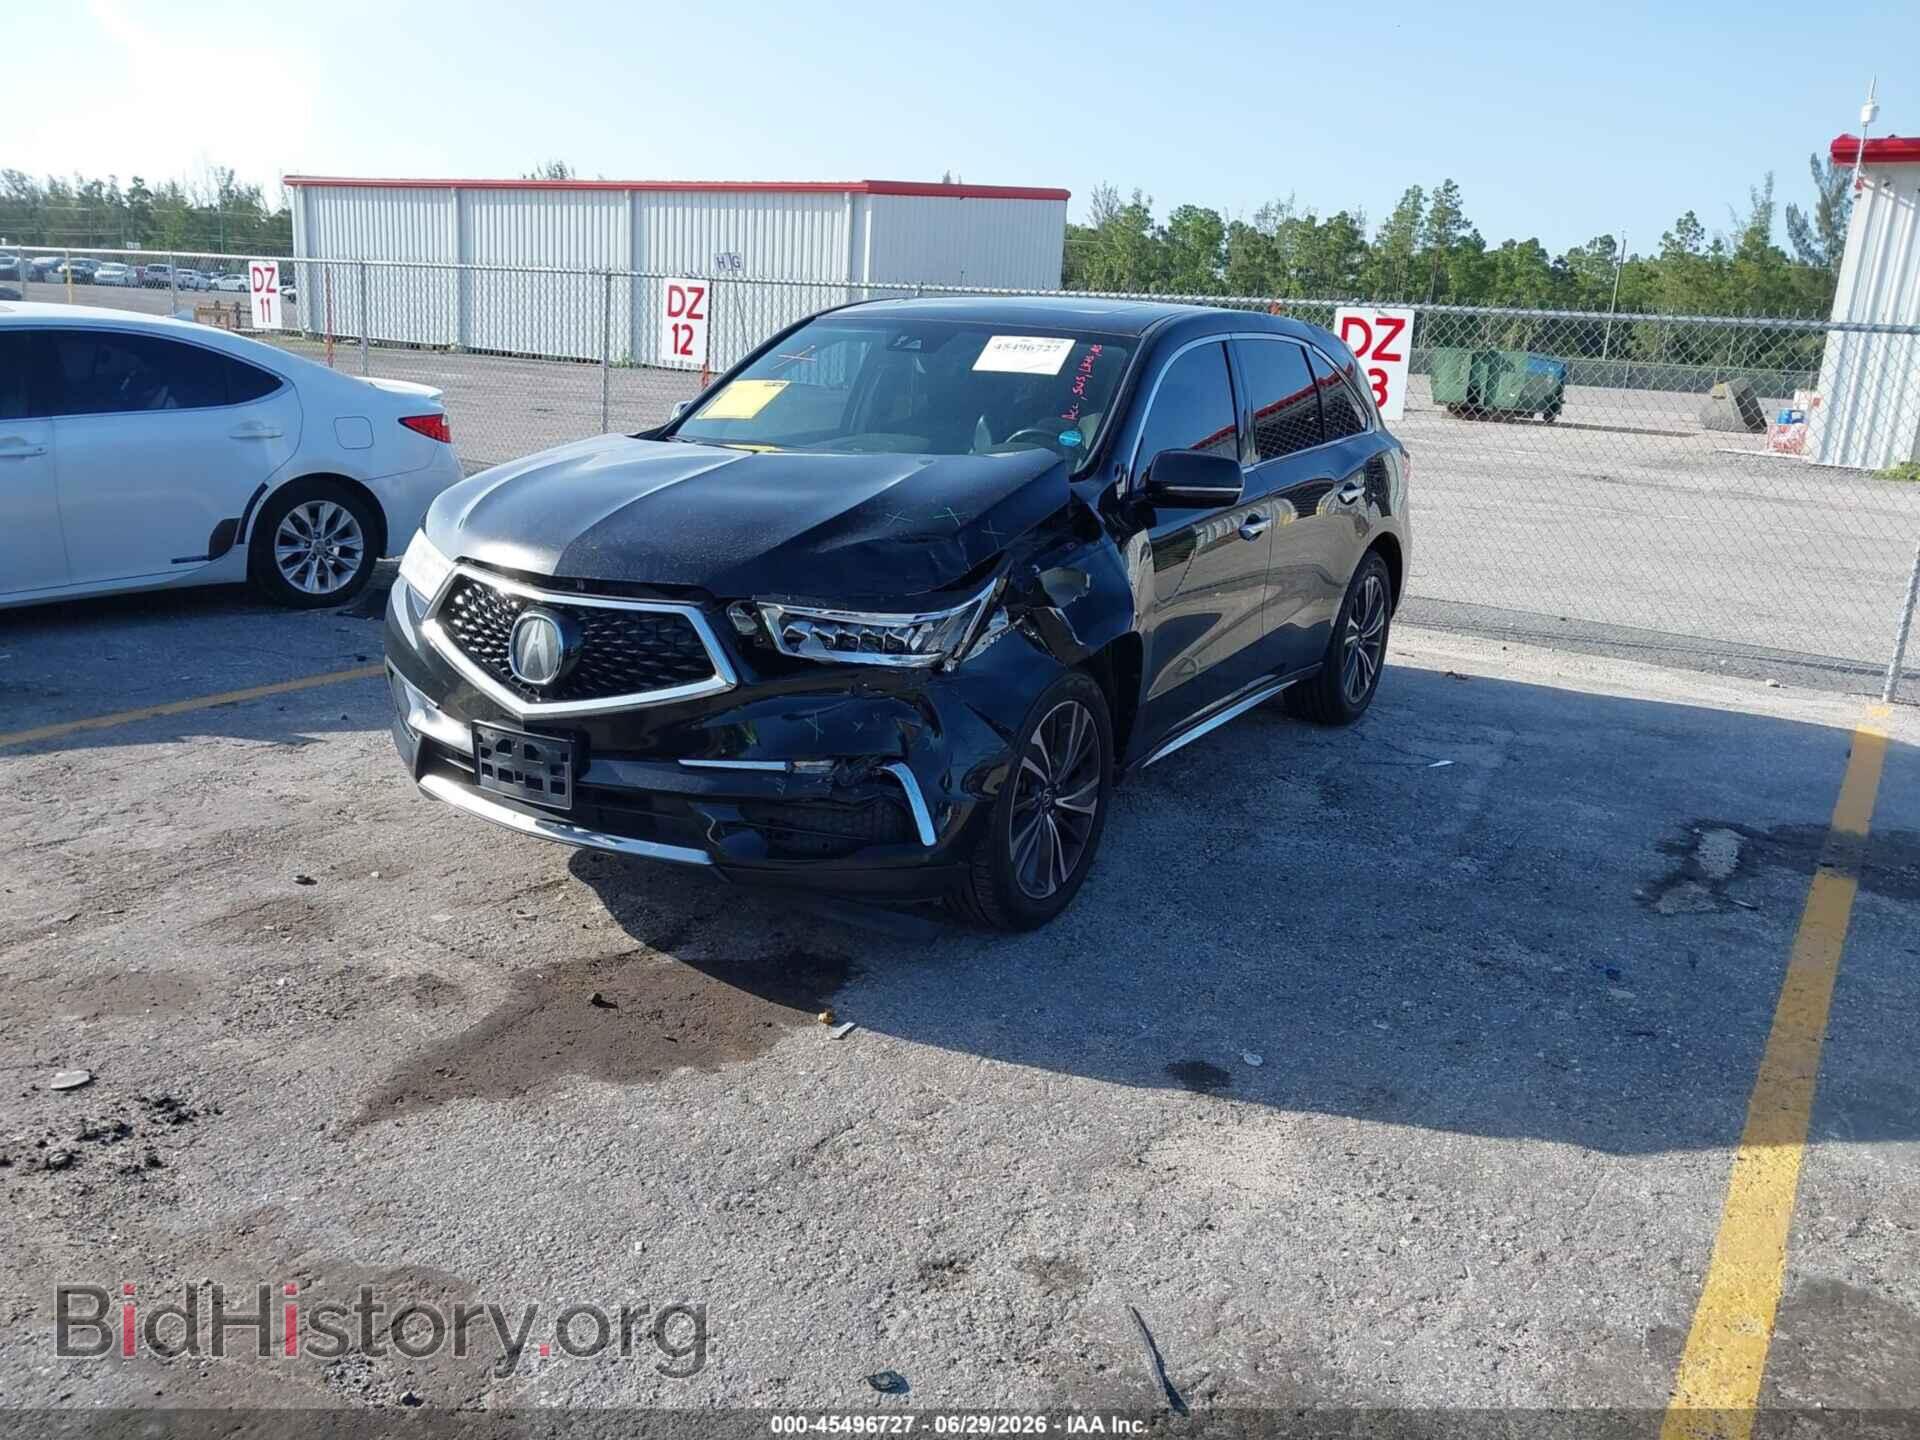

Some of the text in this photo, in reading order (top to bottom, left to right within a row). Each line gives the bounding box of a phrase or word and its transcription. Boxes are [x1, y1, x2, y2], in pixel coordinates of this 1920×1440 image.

[252, 267, 277, 293] DZ
[260, 298, 271, 323] 11
[667, 285, 704, 320] DZ
[672, 323, 694, 355] 12
[993, 343, 1061, 353] 45496727
[1341, 316, 1405, 361] DZ
[1367, 367, 1388, 408] 3
